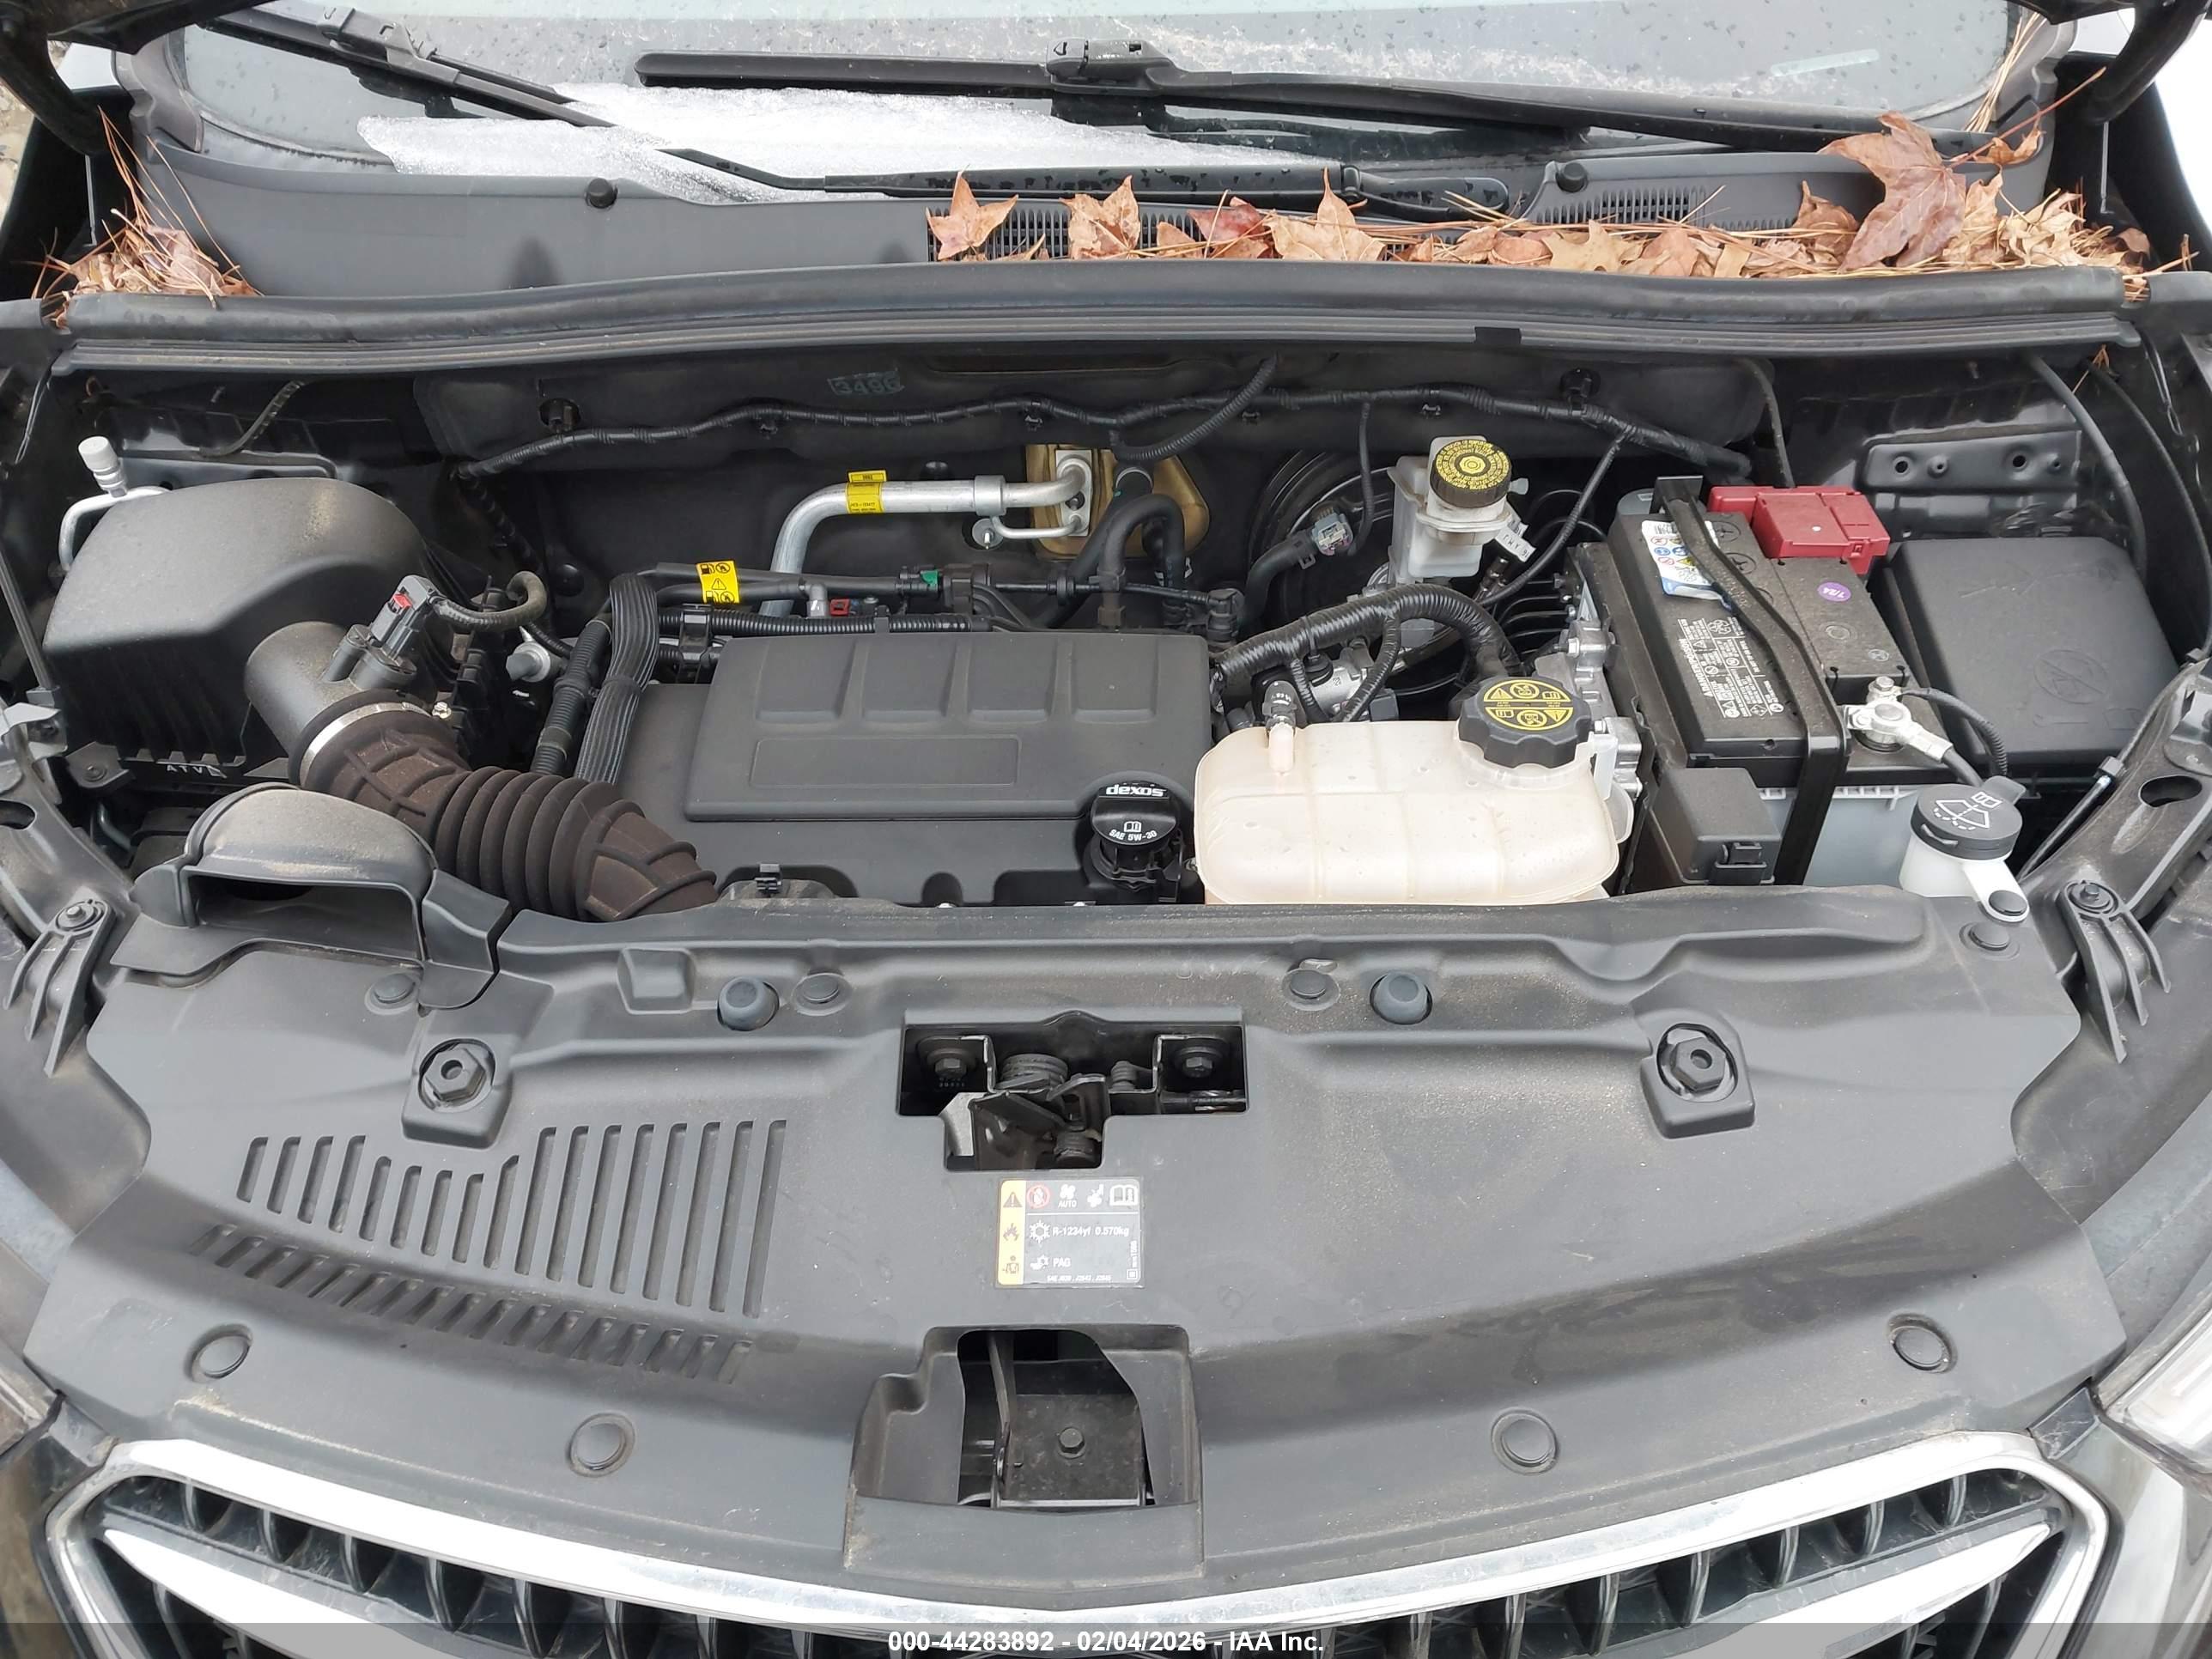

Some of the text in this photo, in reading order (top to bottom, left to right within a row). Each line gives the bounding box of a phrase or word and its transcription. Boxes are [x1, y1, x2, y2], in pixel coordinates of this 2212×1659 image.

[1105, 784, 1167, 797] dexos
[1109, 829, 1158, 842] SAE 5W-30
[1057, 1200, 1078, 1209] AUTO
[1095, 1225, 1130, 1237] 0.570kg
[1053, 1257, 1072, 1268] PAG
